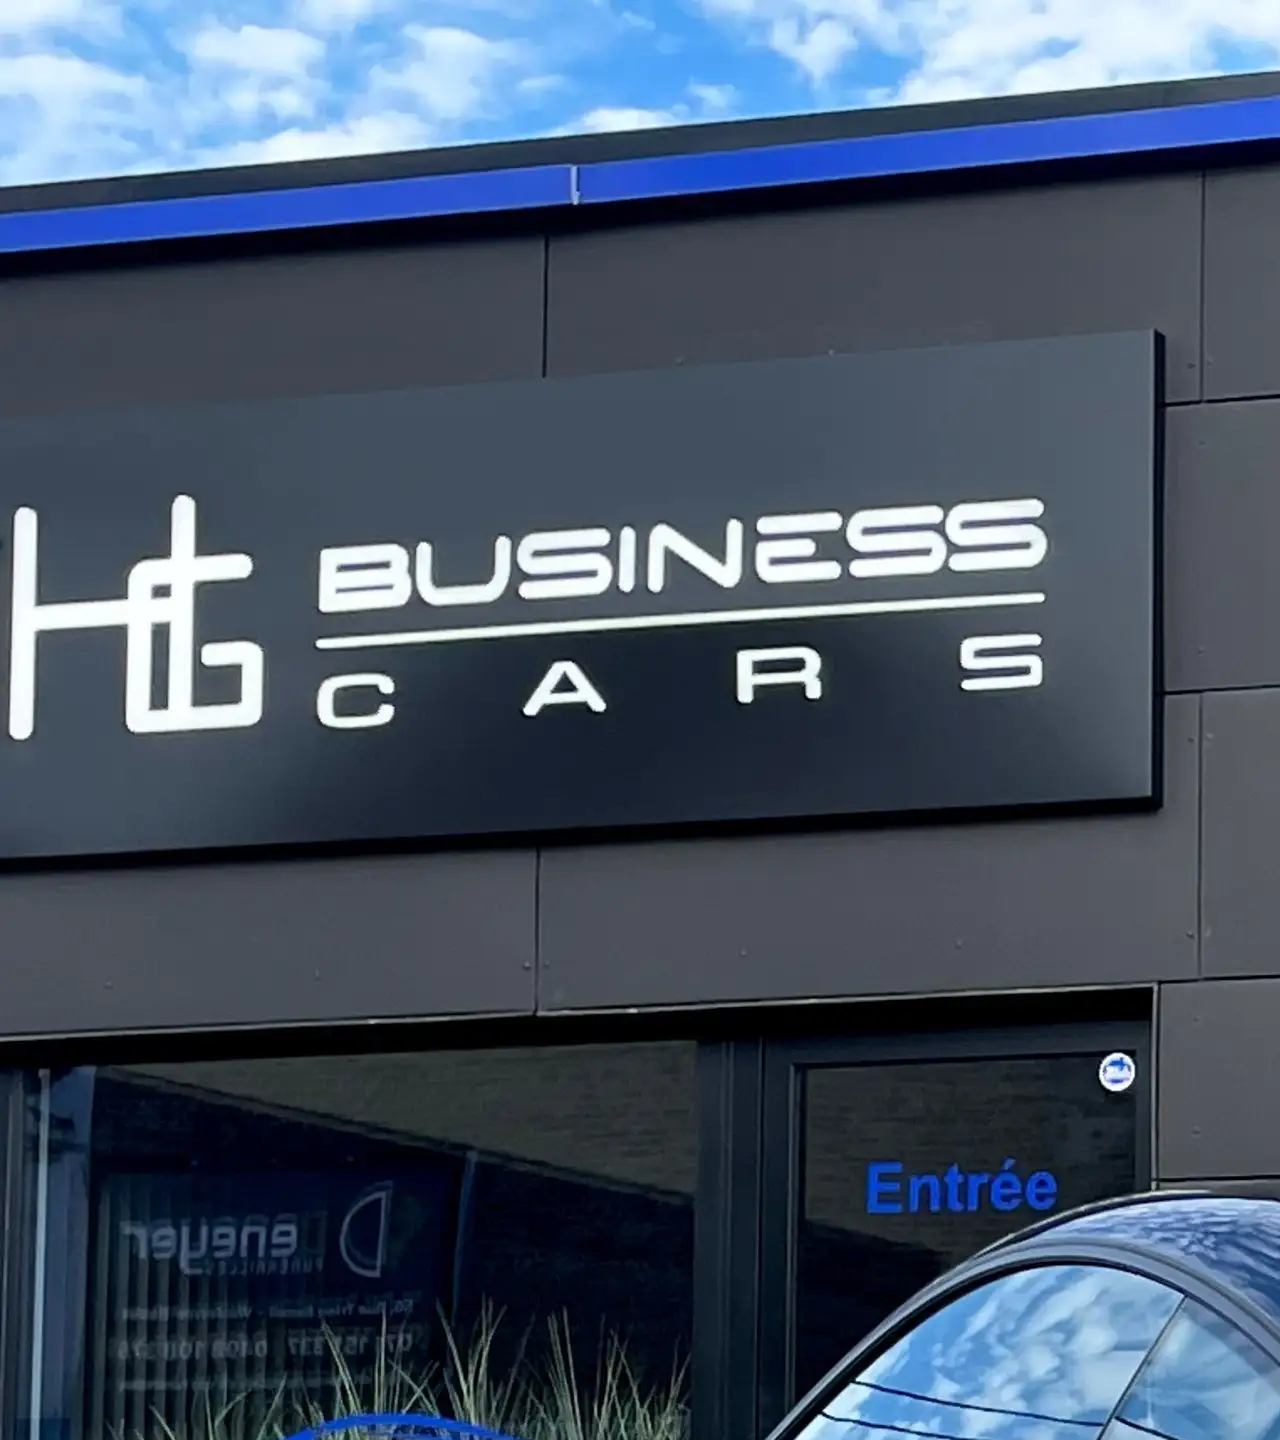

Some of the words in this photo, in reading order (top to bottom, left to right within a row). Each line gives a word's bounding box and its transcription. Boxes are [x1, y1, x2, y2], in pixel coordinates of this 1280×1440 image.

[318, 498, 1047, 612] BUSINESS
[316, 633, 1043, 729] CARS
[867, 1156, 1058, 1214] Entrée
